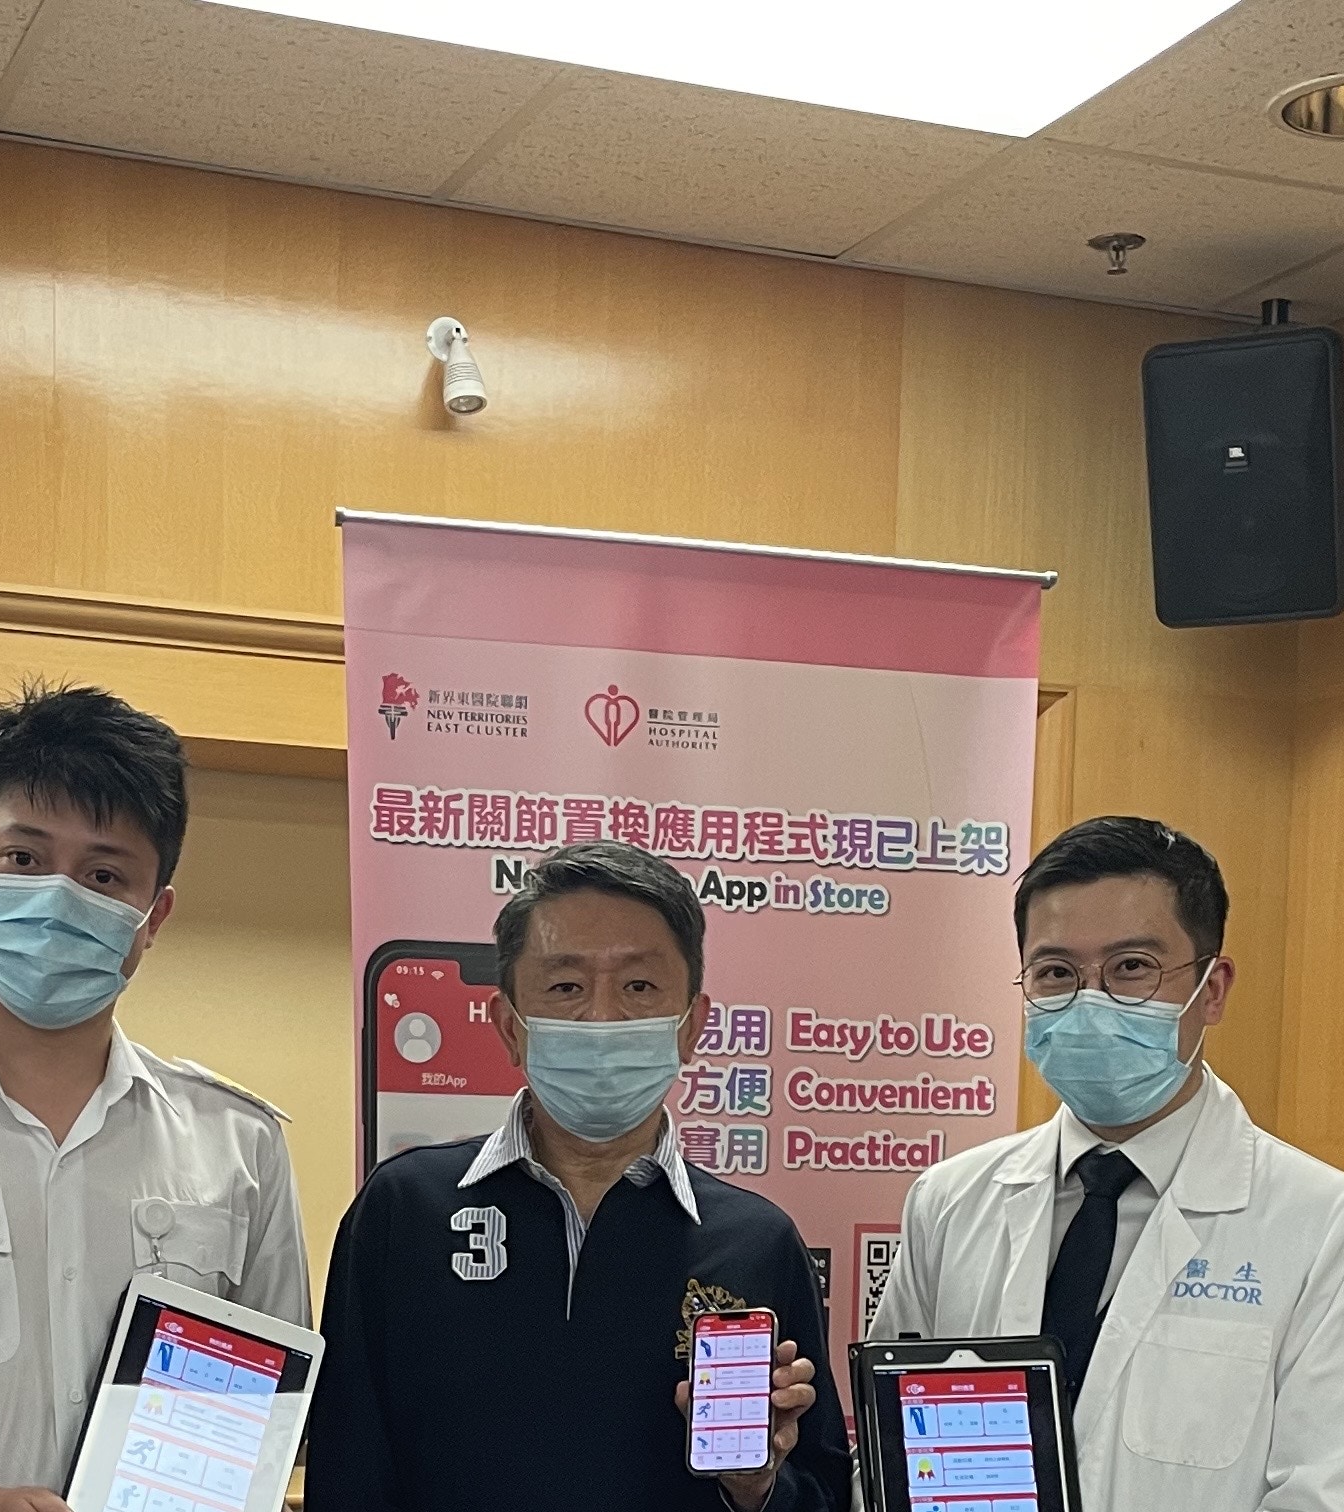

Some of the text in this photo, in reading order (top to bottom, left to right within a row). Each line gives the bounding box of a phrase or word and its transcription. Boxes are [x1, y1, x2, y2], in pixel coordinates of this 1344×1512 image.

[427, 709, 528, 726] NEW TERRITORIES
[427, 721, 528, 739] EAST CLUSTER
[648, 726, 719, 741] HOSPITAL
[648, 738, 718, 751] AUTHORITY
[371, 786, 1007, 872] 最新關節置換應用程式現已上架
[698, 869, 885, 912] App in Store
[396, 965, 425, 976] 09:15
[698, 1007, 766, 1051] 易用
[790, 1010, 989, 1058] Easy to Use
[681, 1065, 767, 1111] 方便
[788, 1070, 992, 1111] Convenient
[680, 1126, 763, 1170] 實用
[786, 1129, 941, 1168] Practical
[450, 1205, 508, 1281] 3
[1174, 1281, 1263, 1306] DOCTOR
